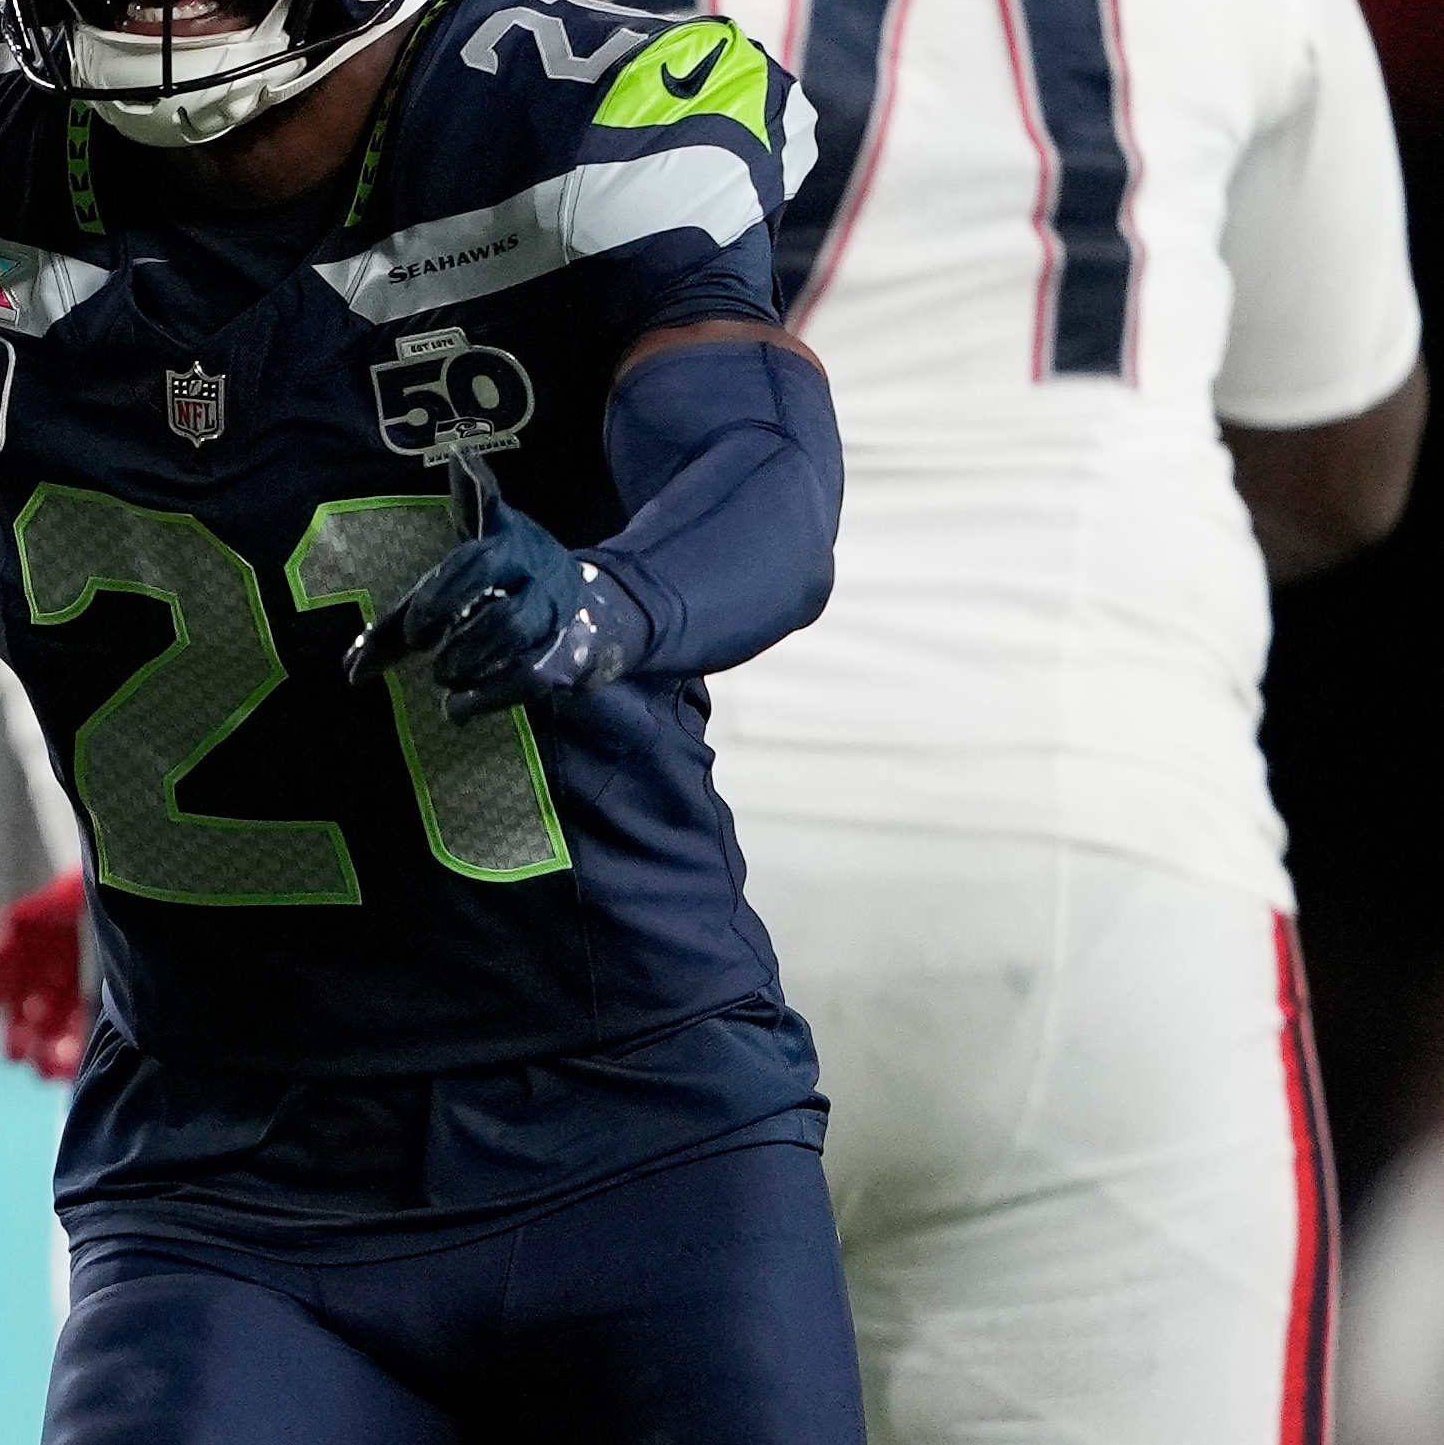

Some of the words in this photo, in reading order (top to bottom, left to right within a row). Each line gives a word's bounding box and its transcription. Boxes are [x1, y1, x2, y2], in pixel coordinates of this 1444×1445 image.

[388, 233, 519, 285] SEAHAWKS
[176, 400, 216, 432] NFL
[377, 350, 529, 449] 50
[13, 481, 573, 905] 21
